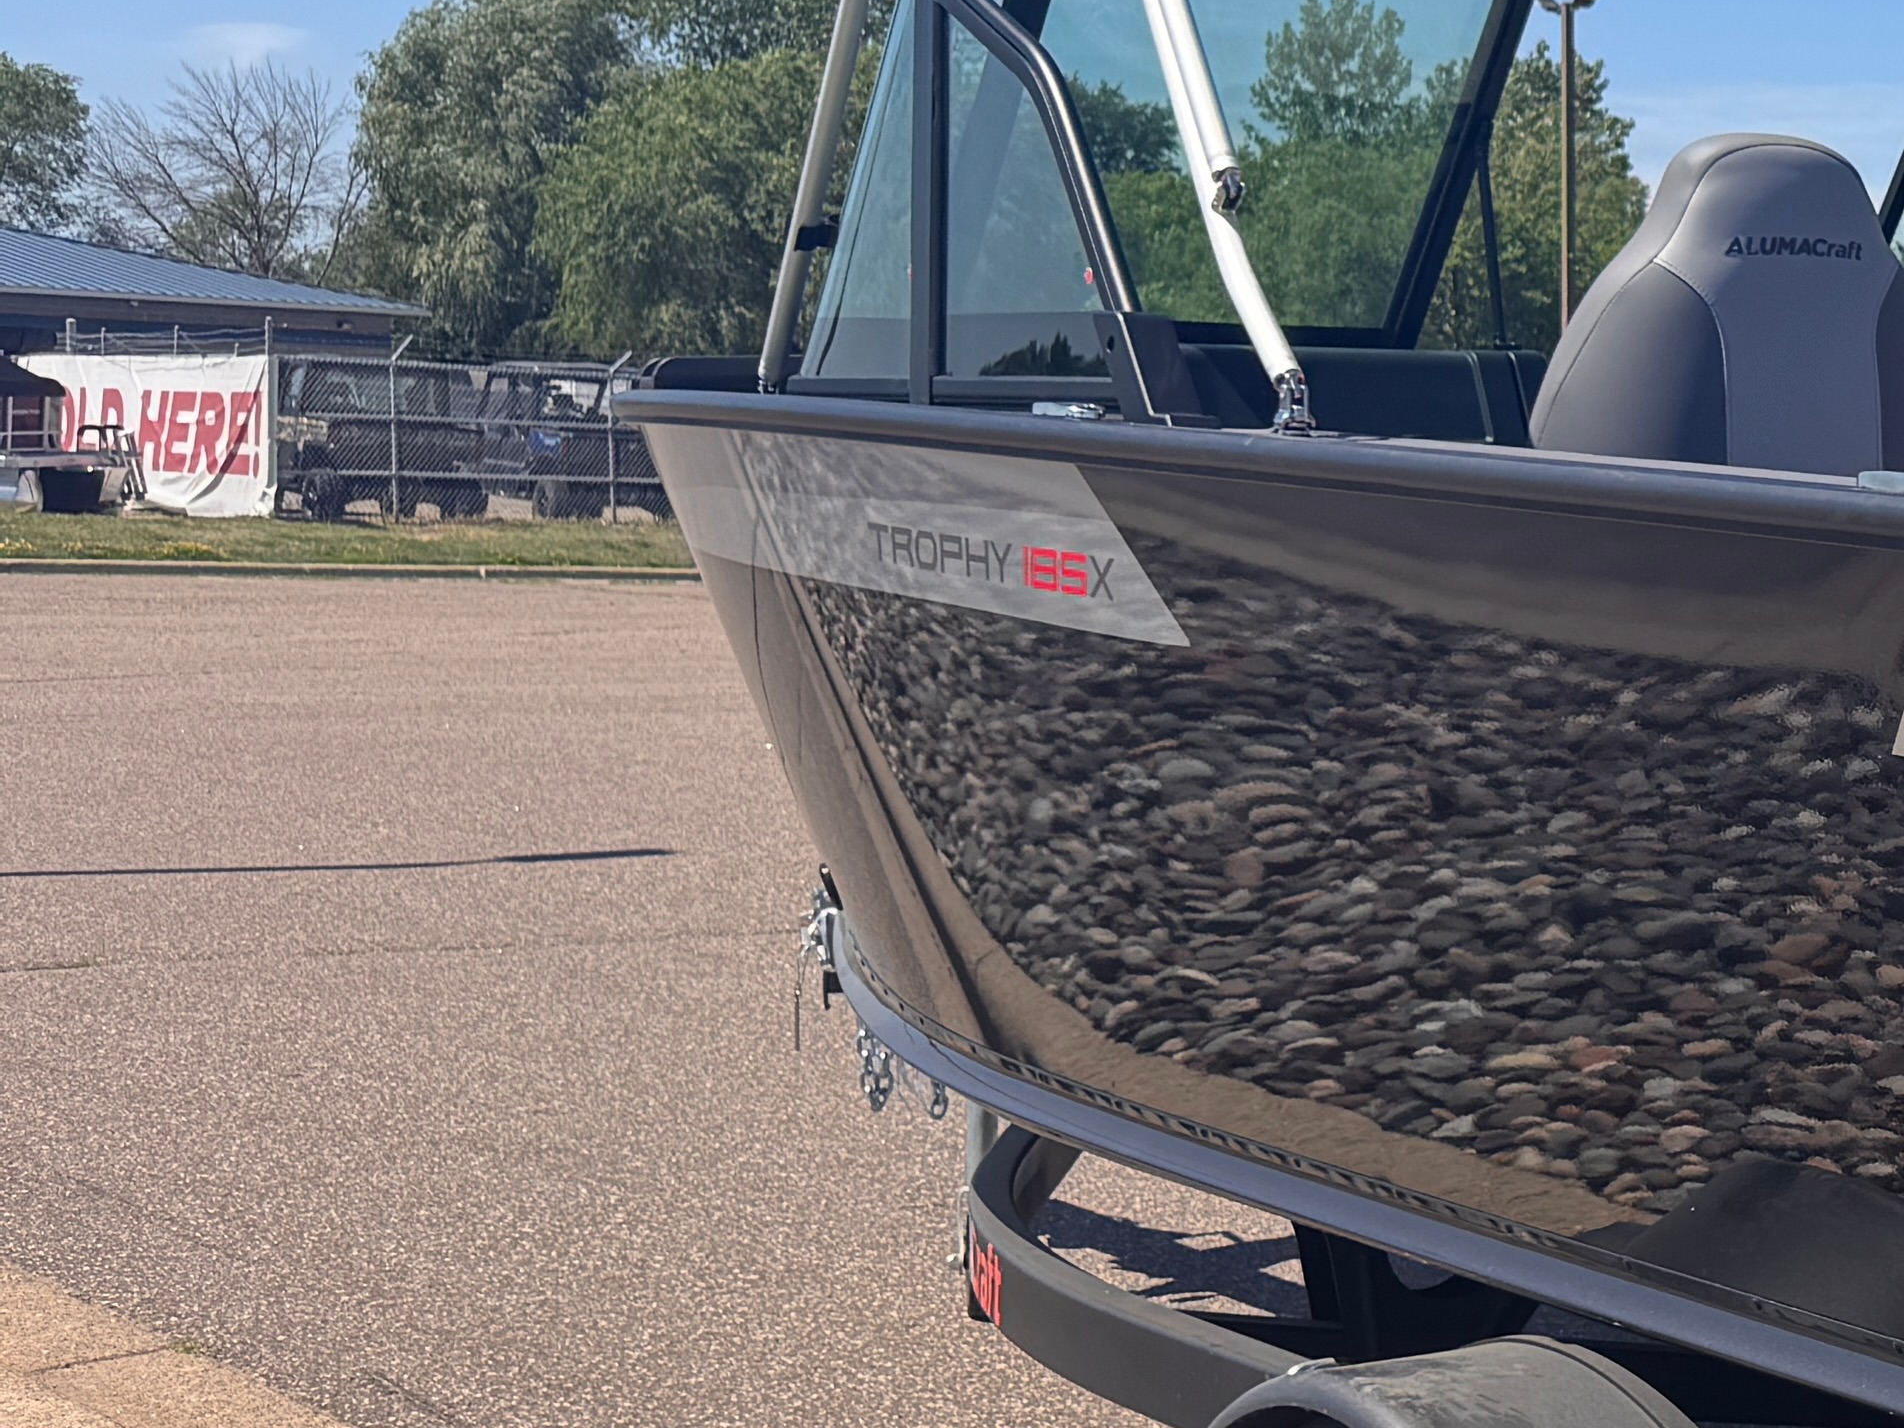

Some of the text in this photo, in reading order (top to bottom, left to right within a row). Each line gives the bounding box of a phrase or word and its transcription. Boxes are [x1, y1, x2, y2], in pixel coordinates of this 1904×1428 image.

[1724, 234, 1863, 262] ALUMACraft
[138, 390, 262, 479] HERE!
[867, 521, 1013, 583] TROPHY
